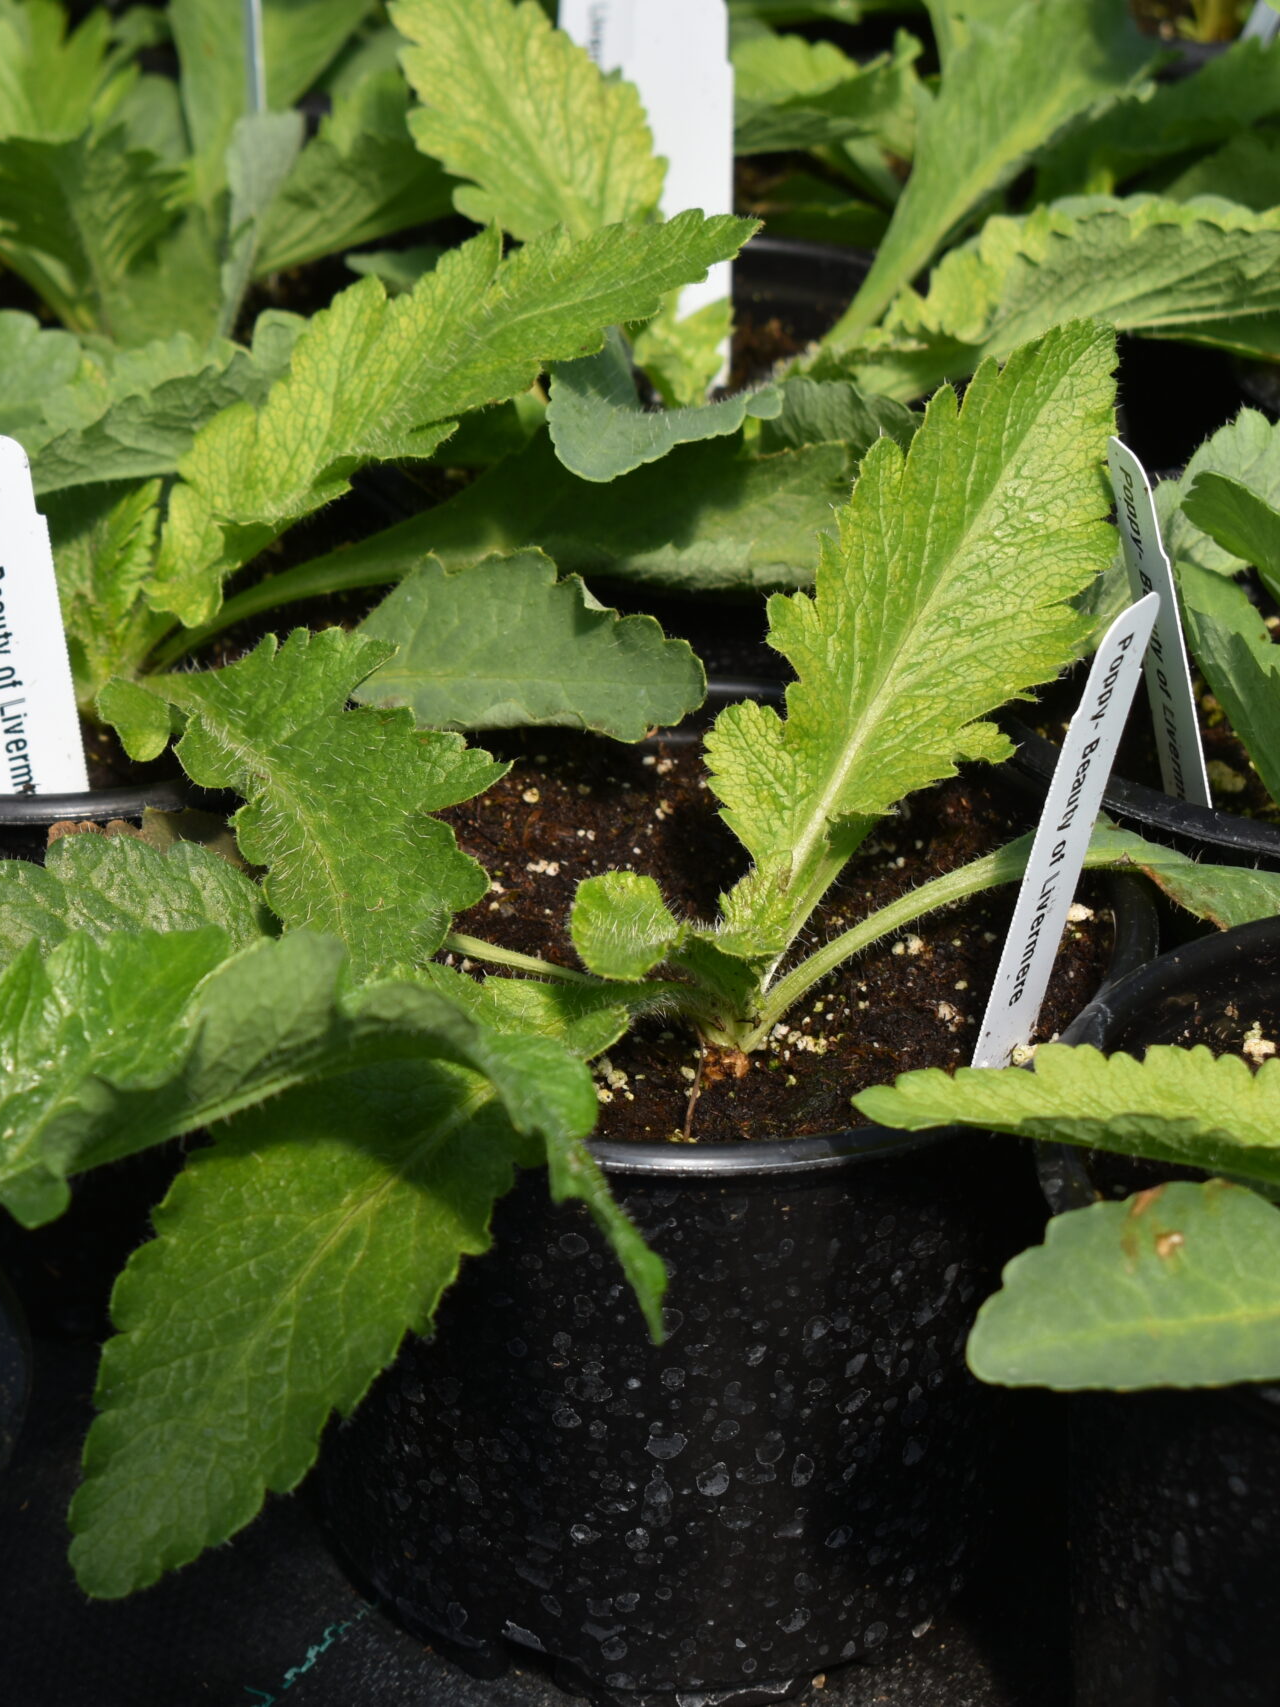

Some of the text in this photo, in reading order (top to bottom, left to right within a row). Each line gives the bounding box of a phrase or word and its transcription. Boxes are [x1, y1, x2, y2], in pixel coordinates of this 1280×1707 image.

[1119, 466, 1144, 560] Poppy-
[1156, 668, 1173, 702] of
[0, 697, 36, 793] Liverm
[1009, 632, 1134, 1007] Poppy- Beauty of Livermere
